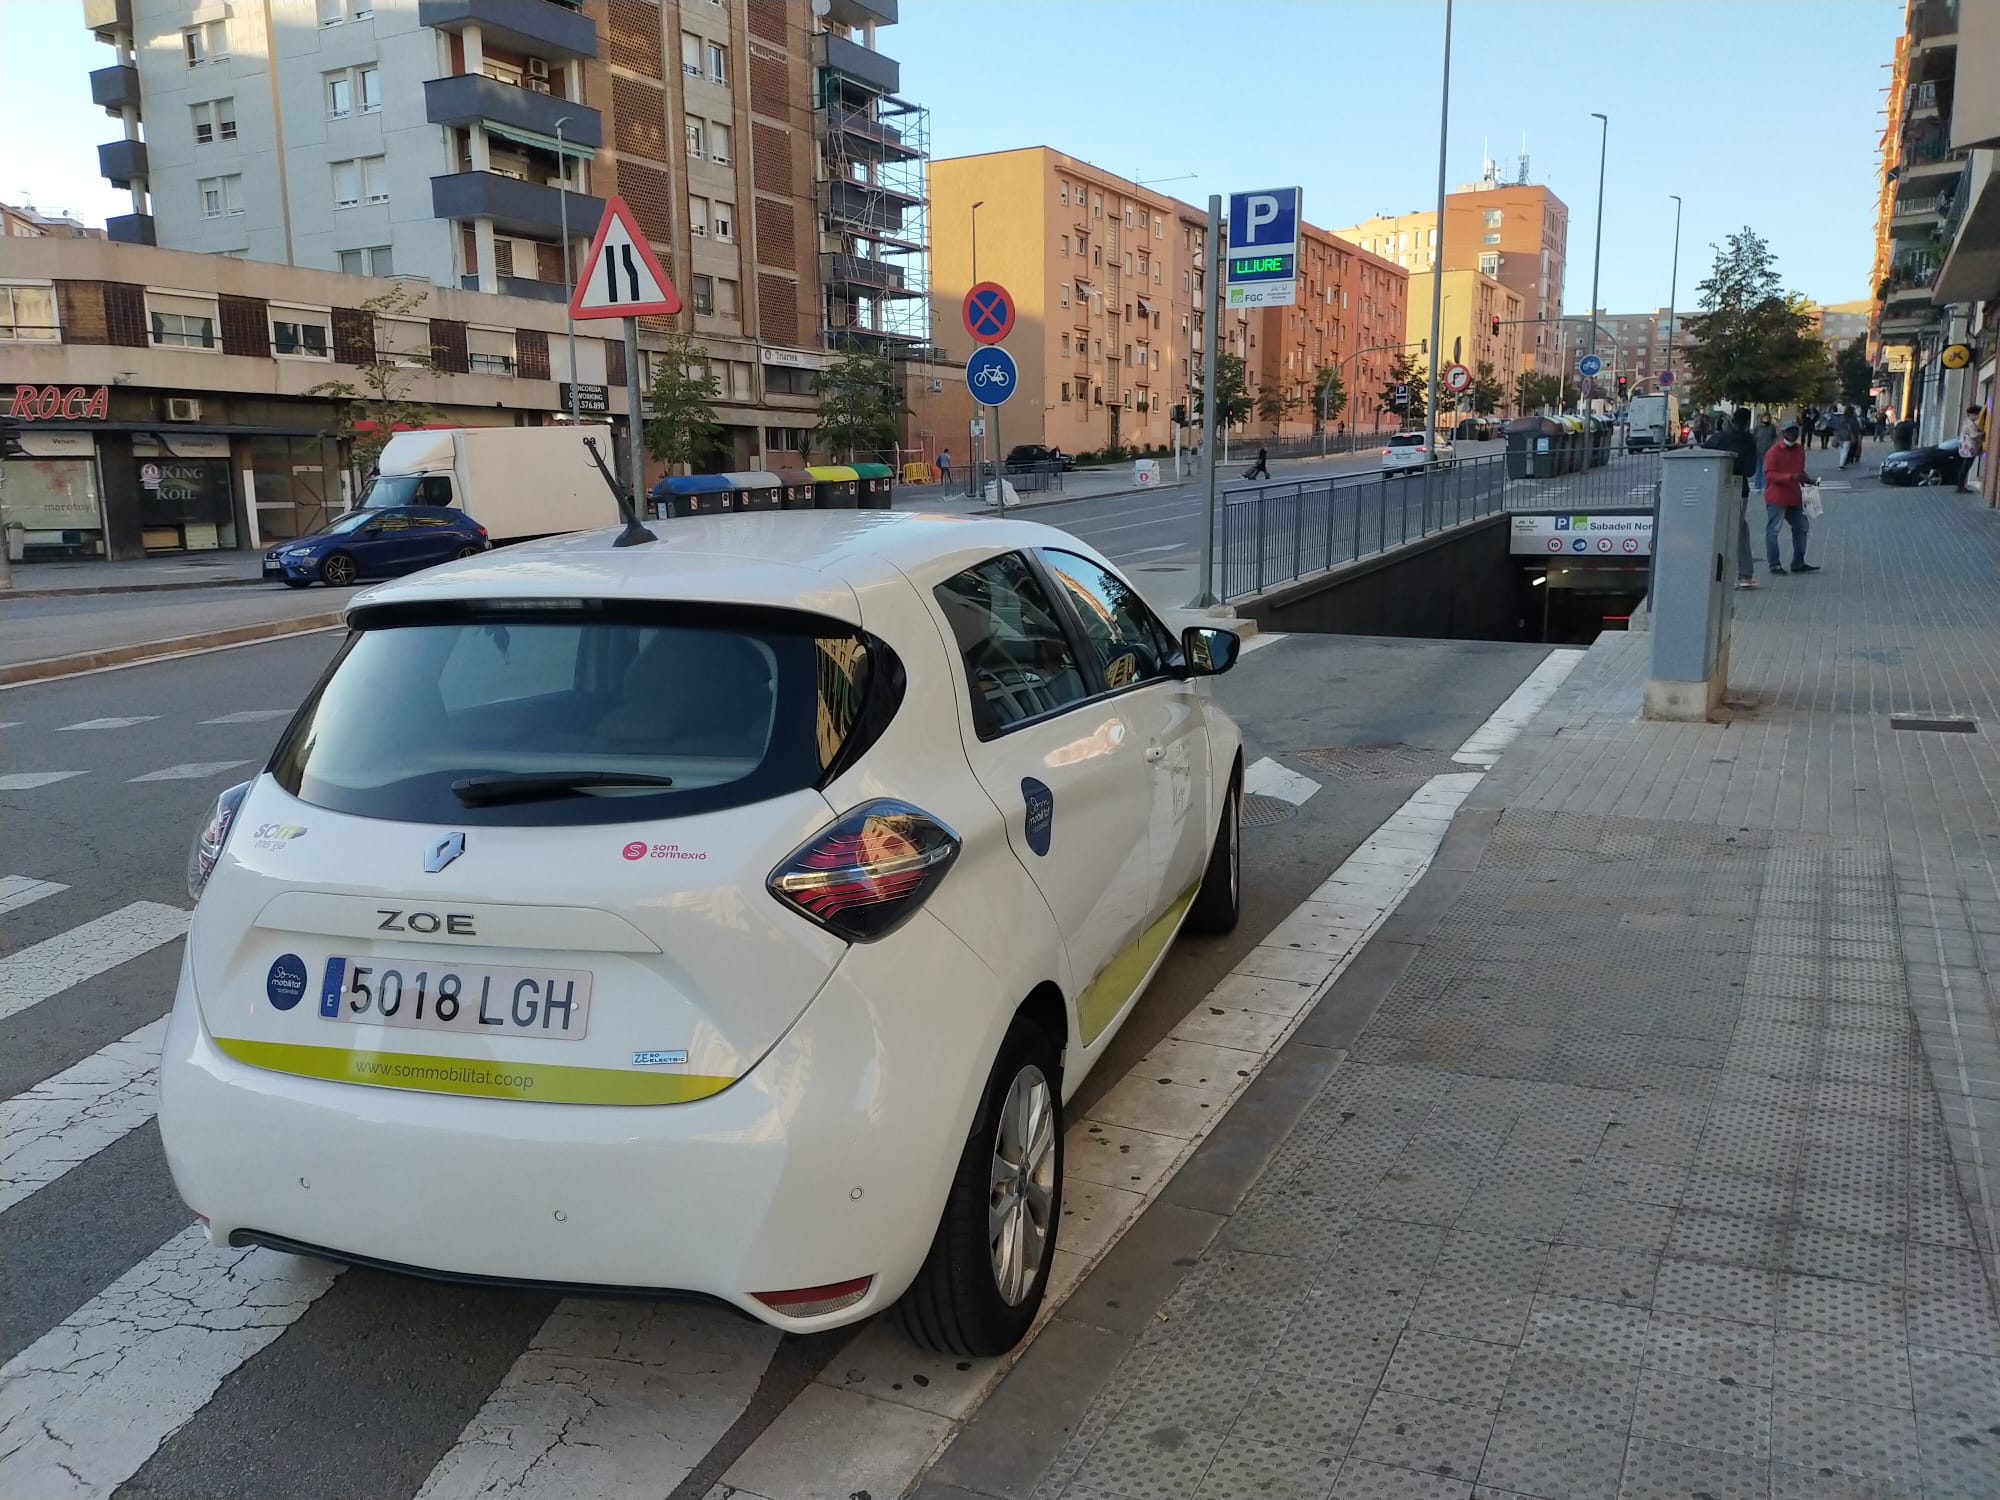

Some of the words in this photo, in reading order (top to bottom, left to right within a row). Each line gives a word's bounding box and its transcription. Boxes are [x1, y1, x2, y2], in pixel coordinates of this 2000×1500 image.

[1246, 195, 1279, 243] P
[1236, 258, 1283, 274] LLIURE
[1245, 293, 1263, 302] FGC
[569, 385, 602, 393] CNCORDIA
[10, 385, 109, 421] ROCA
[161, 466, 203, 479] KING
[1557, 518, 1567, 529] P
[1590, 522, 1631, 530] Sabadell
[650, 851, 707, 860] connexió
[377, 910, 477, 936] ZOE
[326, 993, 335, 1007] E
[349, 966, 462, 1022] 5018
[478, 975, 575, 1030] LGH
[355, 1060, 535, 1092] www.sommobilitat.coop
